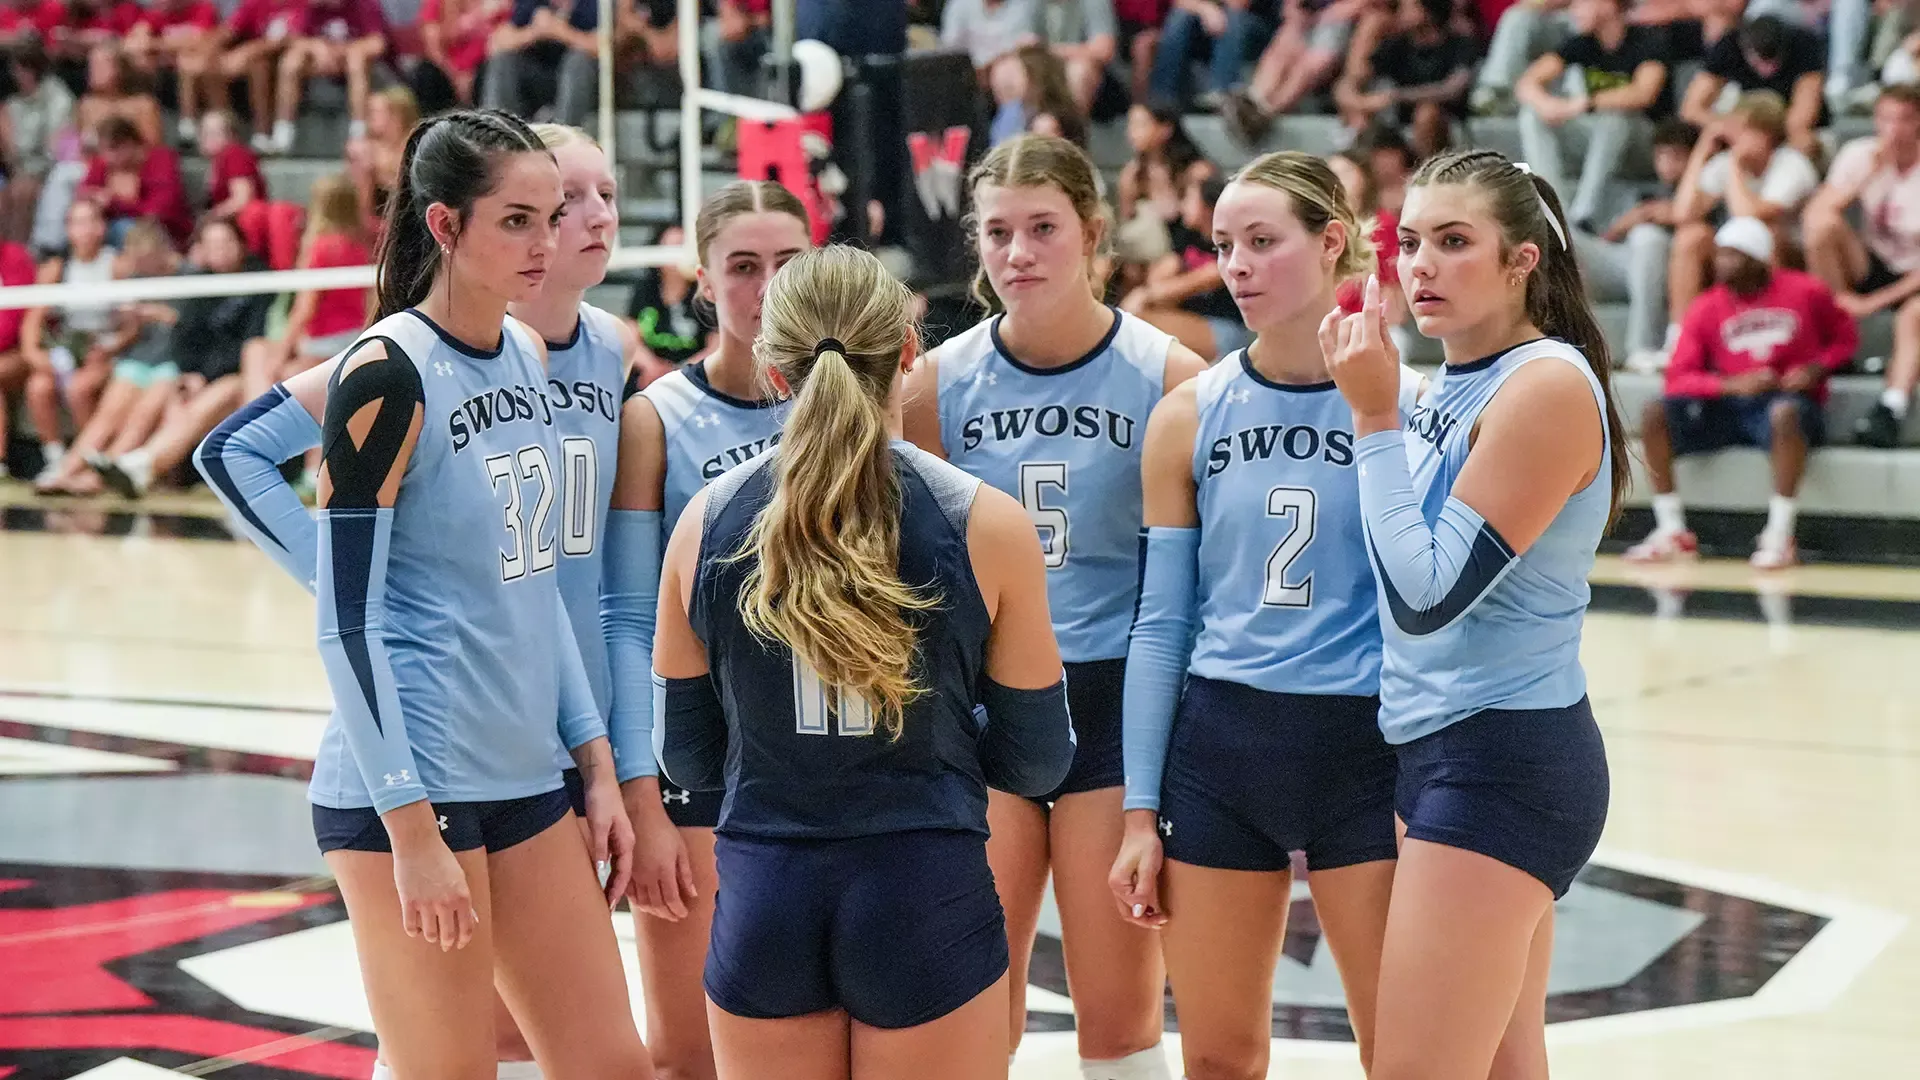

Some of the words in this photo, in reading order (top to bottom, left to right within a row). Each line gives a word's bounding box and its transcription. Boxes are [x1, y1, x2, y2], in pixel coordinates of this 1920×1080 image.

[548, 379, 615, 423] OSU
[963, 404, 1135, 452] SWOSU
[1206, 424, 1355, 479] SWOS
[484, 443, 556, 584] 32
[1018, 460, 1070, 570] 5
[1263, 485, 1316, 609] 2
